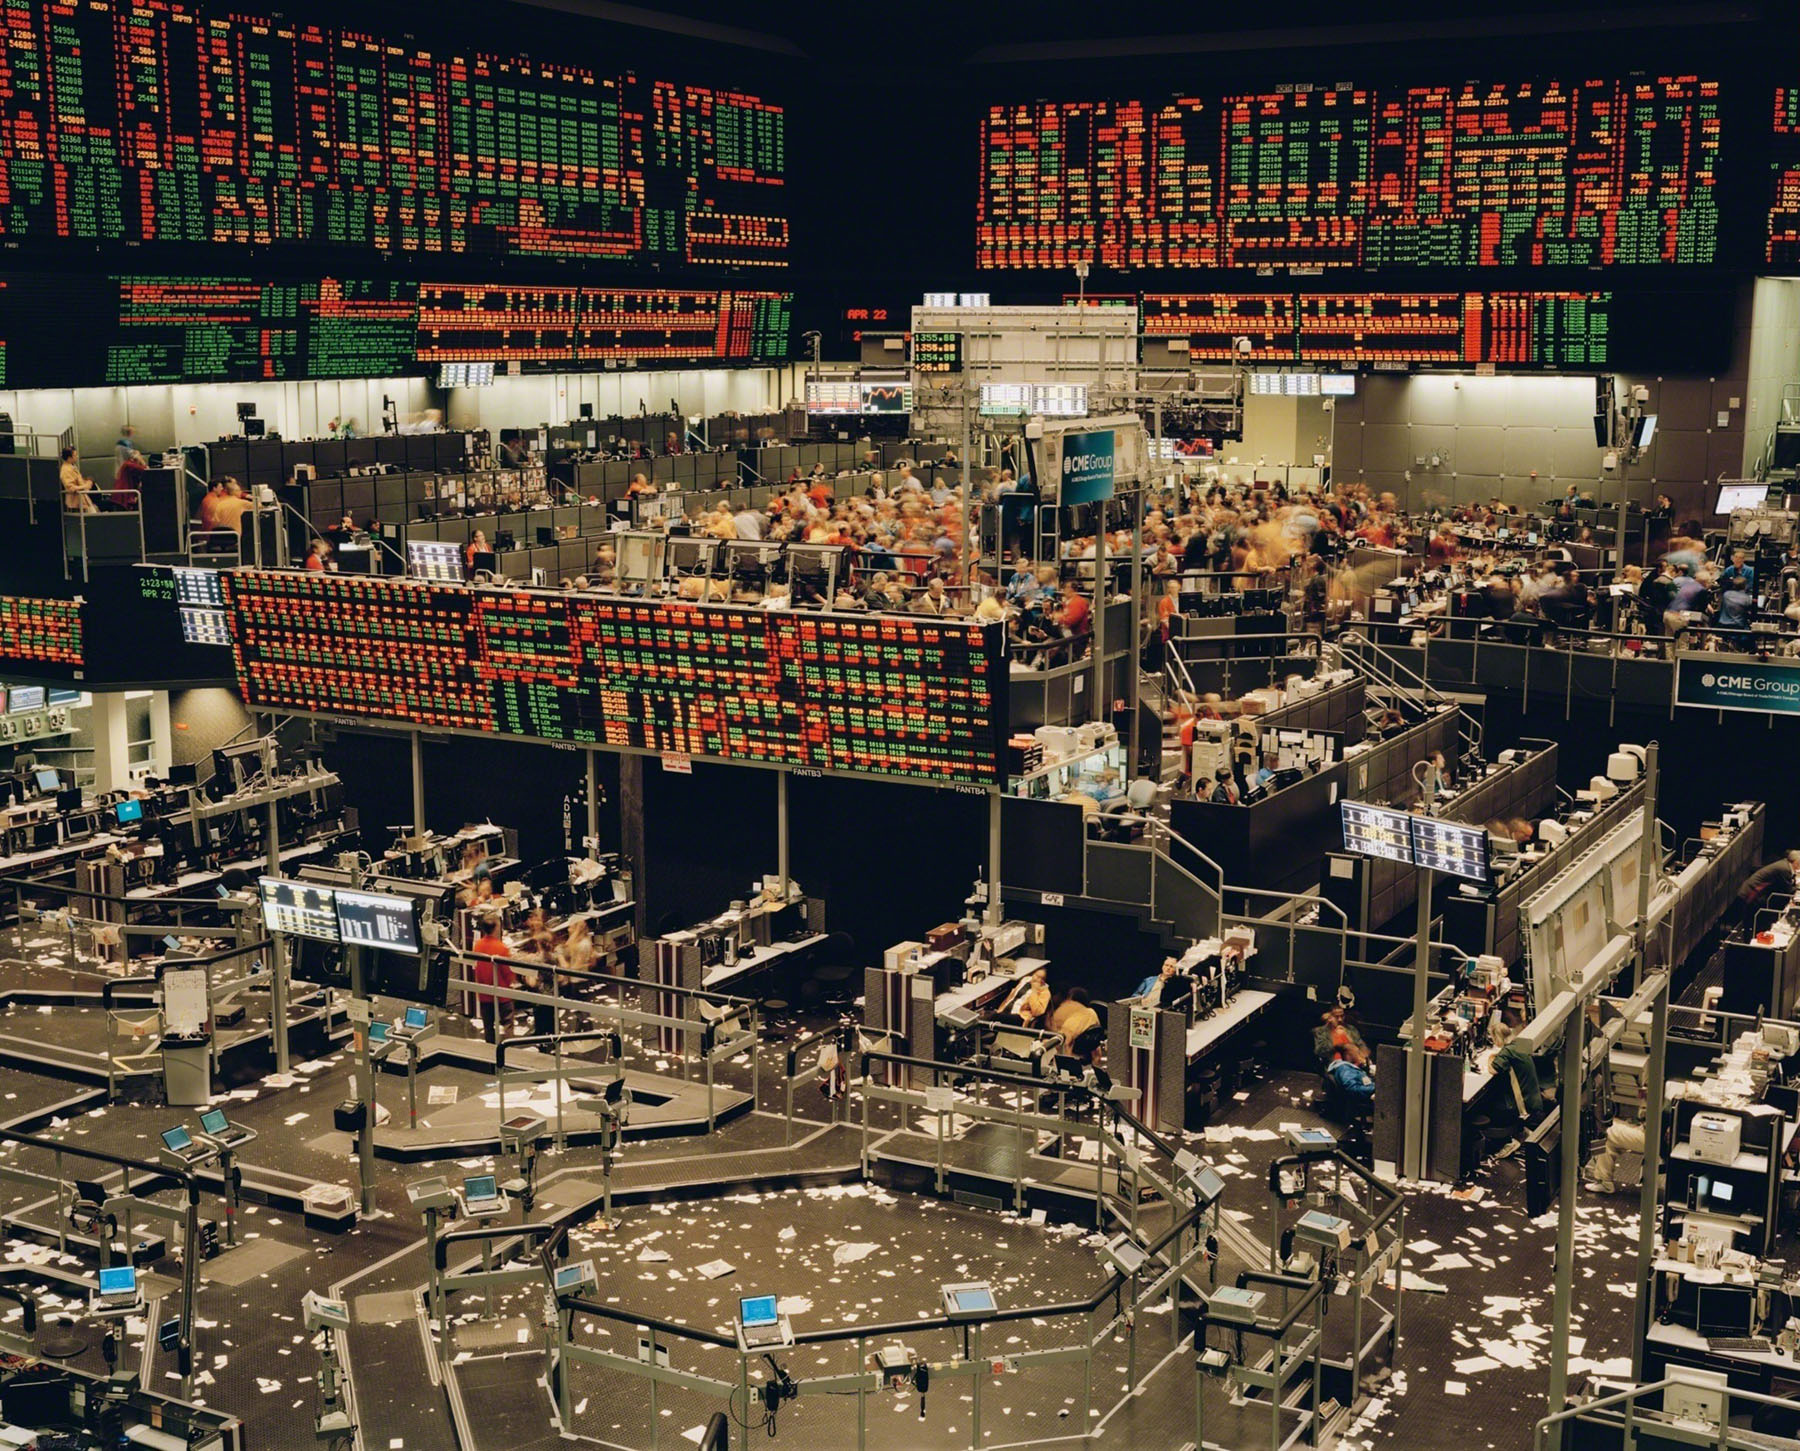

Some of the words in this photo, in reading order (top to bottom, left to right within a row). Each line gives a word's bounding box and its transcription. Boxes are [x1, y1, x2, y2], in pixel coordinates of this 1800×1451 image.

[847, 309, 868, 319] APR
[873, 309, 887, 319] 22
[1072, 454, 1089, 472] CME
[1089, 453, 1112, 471] Group
[142, 589, 158, 599] APR
[162, 590, 172, 599] 22
[1717, 676, 1752, 689] CME
[1754, 678, 1800, 695] Group
[552, 742, 576, 751] FANTB2
[793, 767, 821, 778] FANTB3
[956, 785, 985, 795] FANTB4
